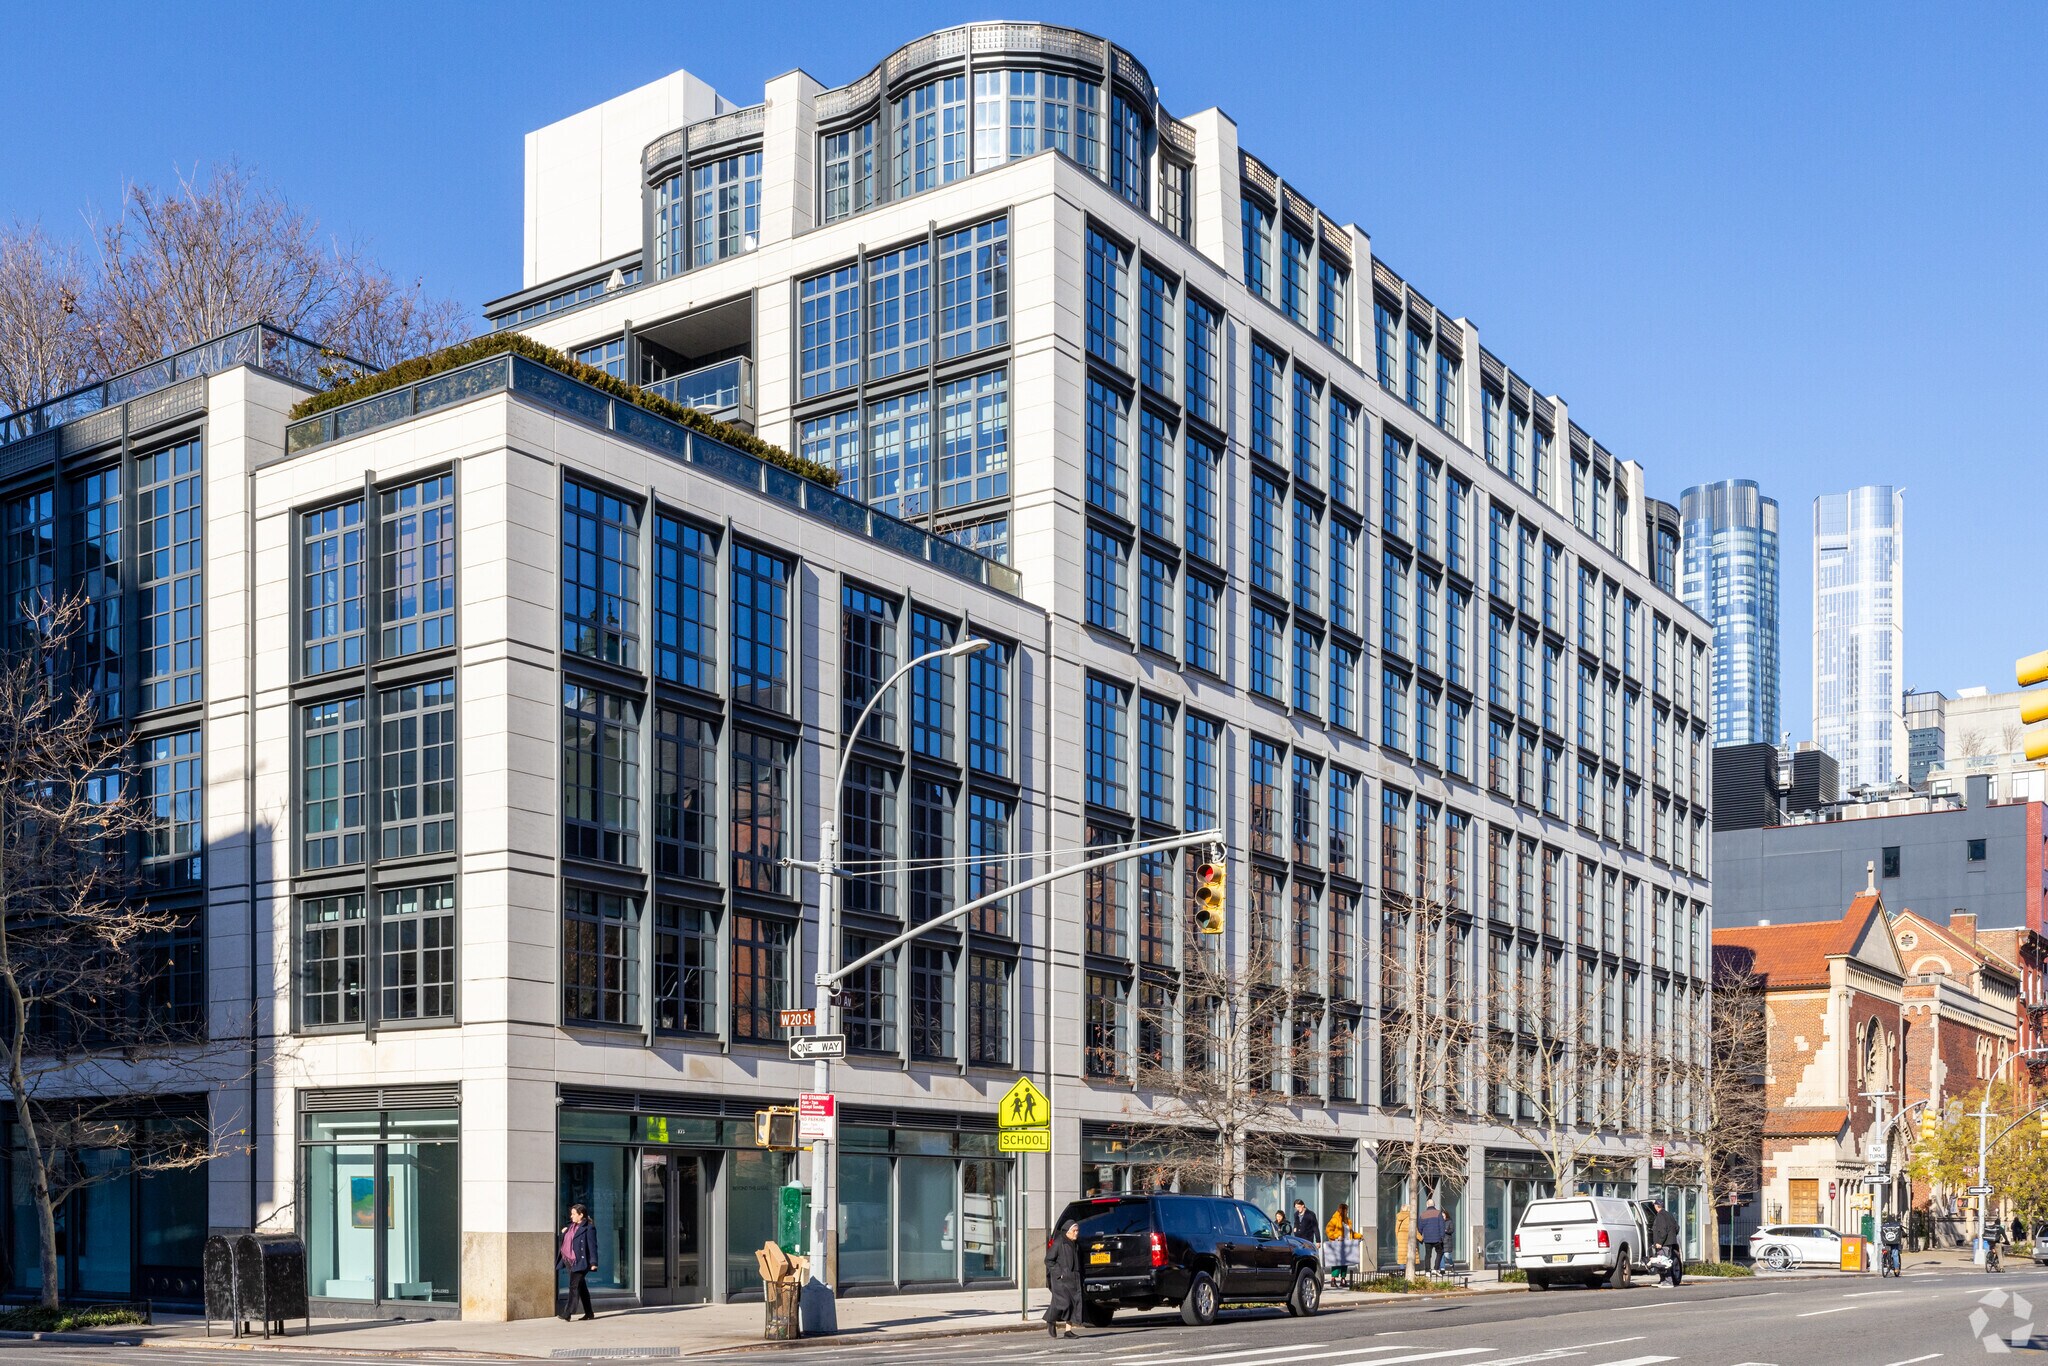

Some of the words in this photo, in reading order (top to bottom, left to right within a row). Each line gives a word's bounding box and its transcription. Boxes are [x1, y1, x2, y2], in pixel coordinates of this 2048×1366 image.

[844, 996, 852, 1006] Av
[782, 1014, 789, 1025] W
[790, 1014, 801, 1025] 20
[802, 1013, 812, 1025] St
[797, 1043, 813, 1052] ONE
[822, 1042, 840, 1051] WAY
[1004, 1135, 1045, 1144] SCHOOL
